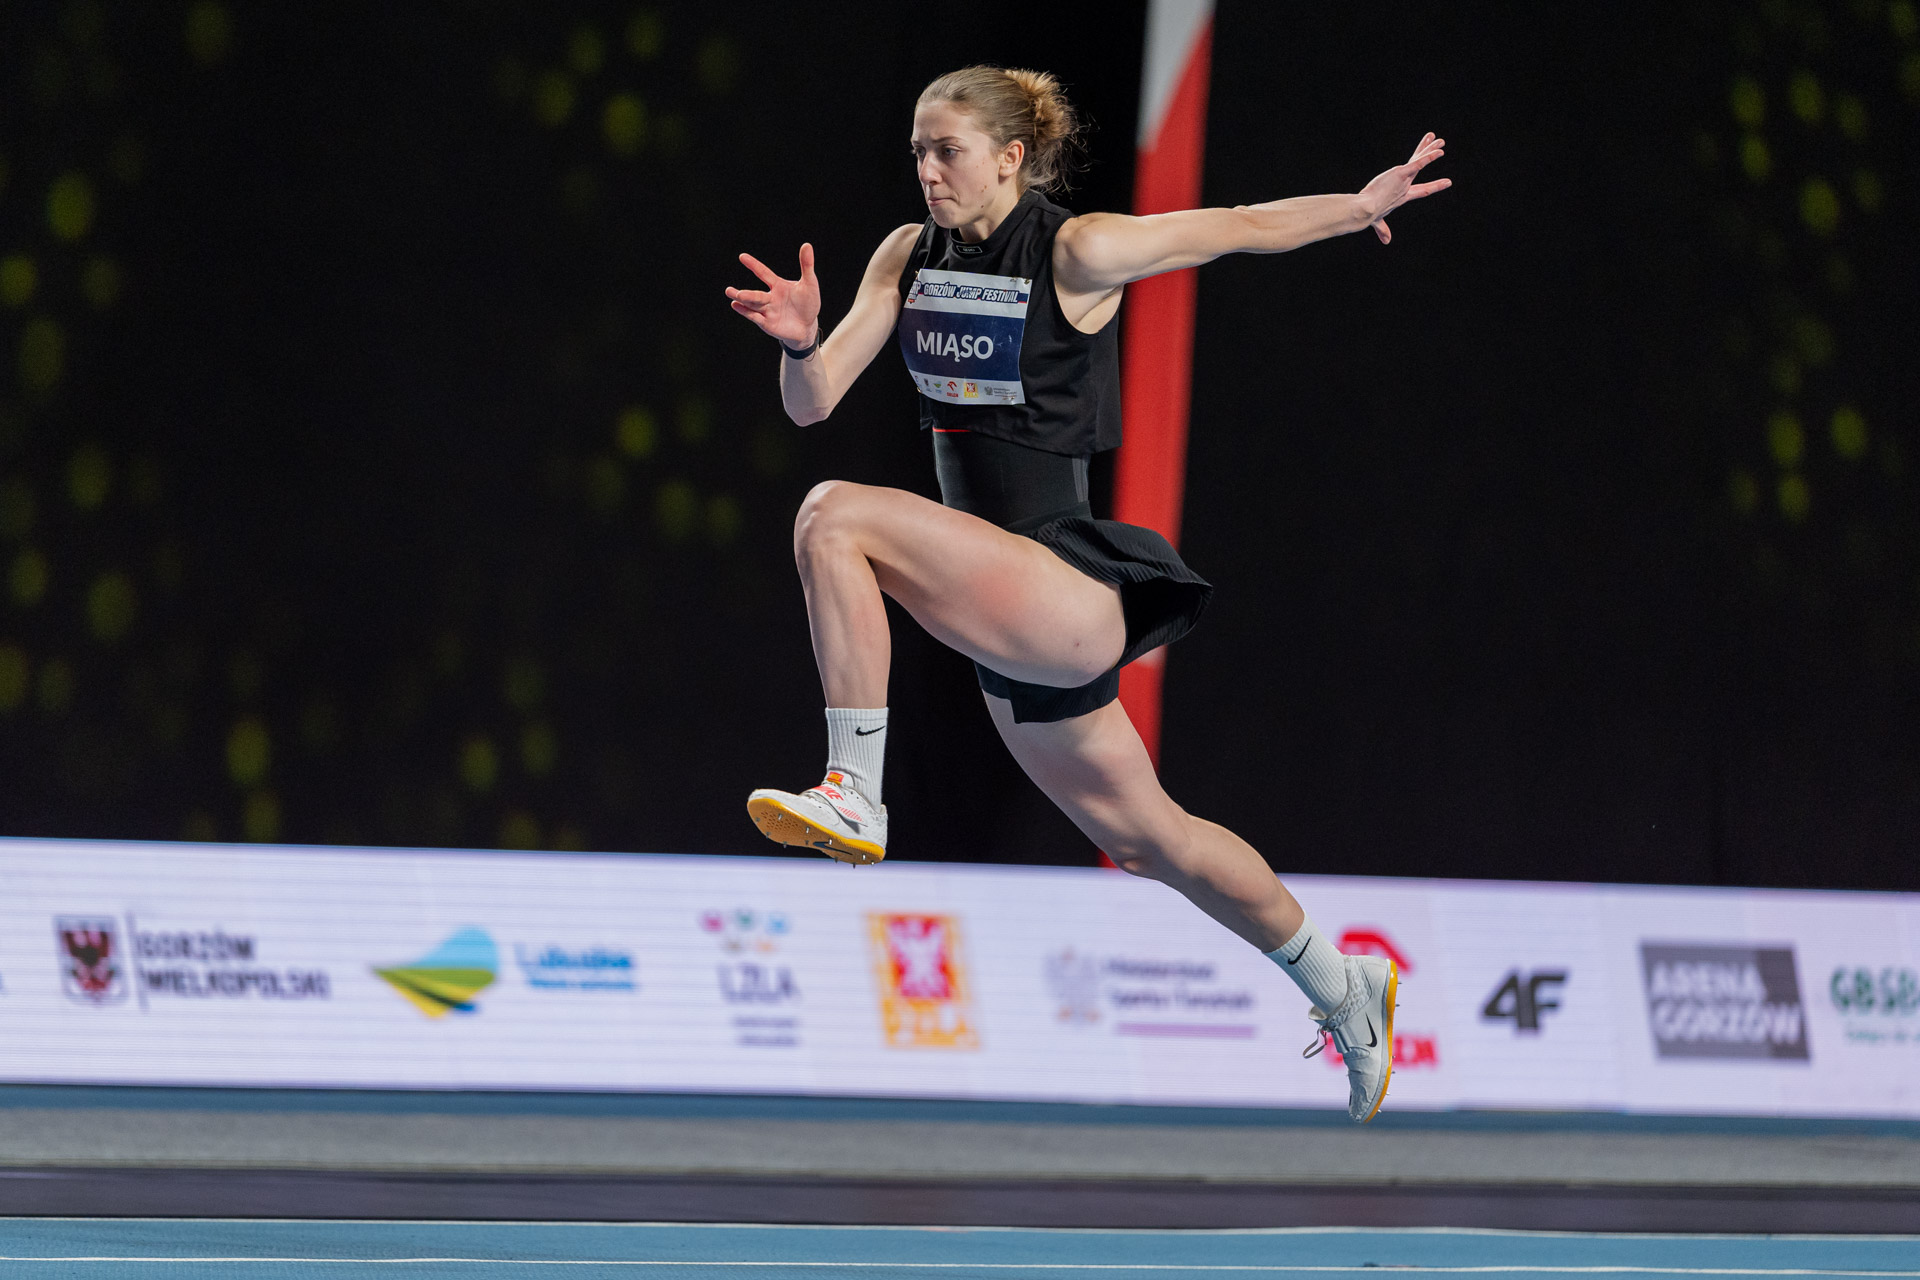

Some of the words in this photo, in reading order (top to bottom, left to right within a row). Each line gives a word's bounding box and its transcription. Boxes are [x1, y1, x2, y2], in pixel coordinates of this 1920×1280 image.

[924, 281, 956, 297] GORZÓW
[982, 288, 1019, 303] FESTIVAL
[916, 330, 994, 363] MIĄSO
[140, 967, 331, 1000] WIELKOPOLSKI
[1651, 961, 1766, 997] ARENA
[1481, 970, 1568, 1034] 4F
